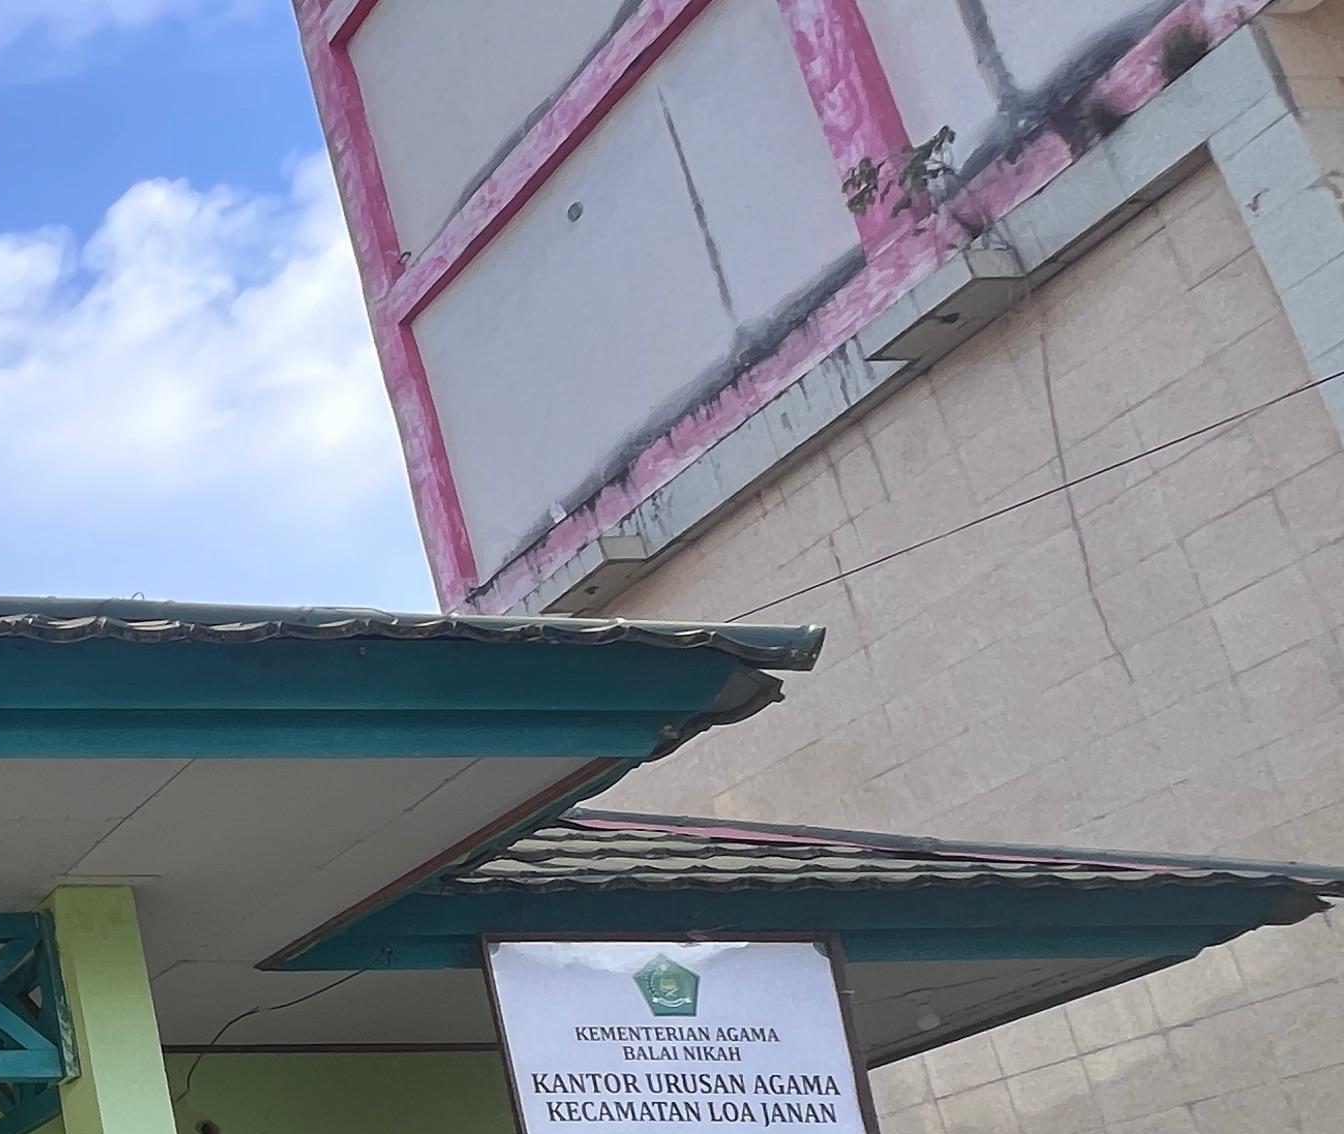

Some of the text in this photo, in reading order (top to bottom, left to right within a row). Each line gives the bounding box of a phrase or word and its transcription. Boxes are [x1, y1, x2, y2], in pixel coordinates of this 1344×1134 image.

[575, 1026, 780, 1042] KEMENTERIAN AGAMA
[623, 1046, 741, 1062] BALAI NIKAH
[532, 1073, 841, 1096] KANTOR URUSAN AGAMA
[547, 1101, 837, 1127] KECAMATAN LOA JANAN
